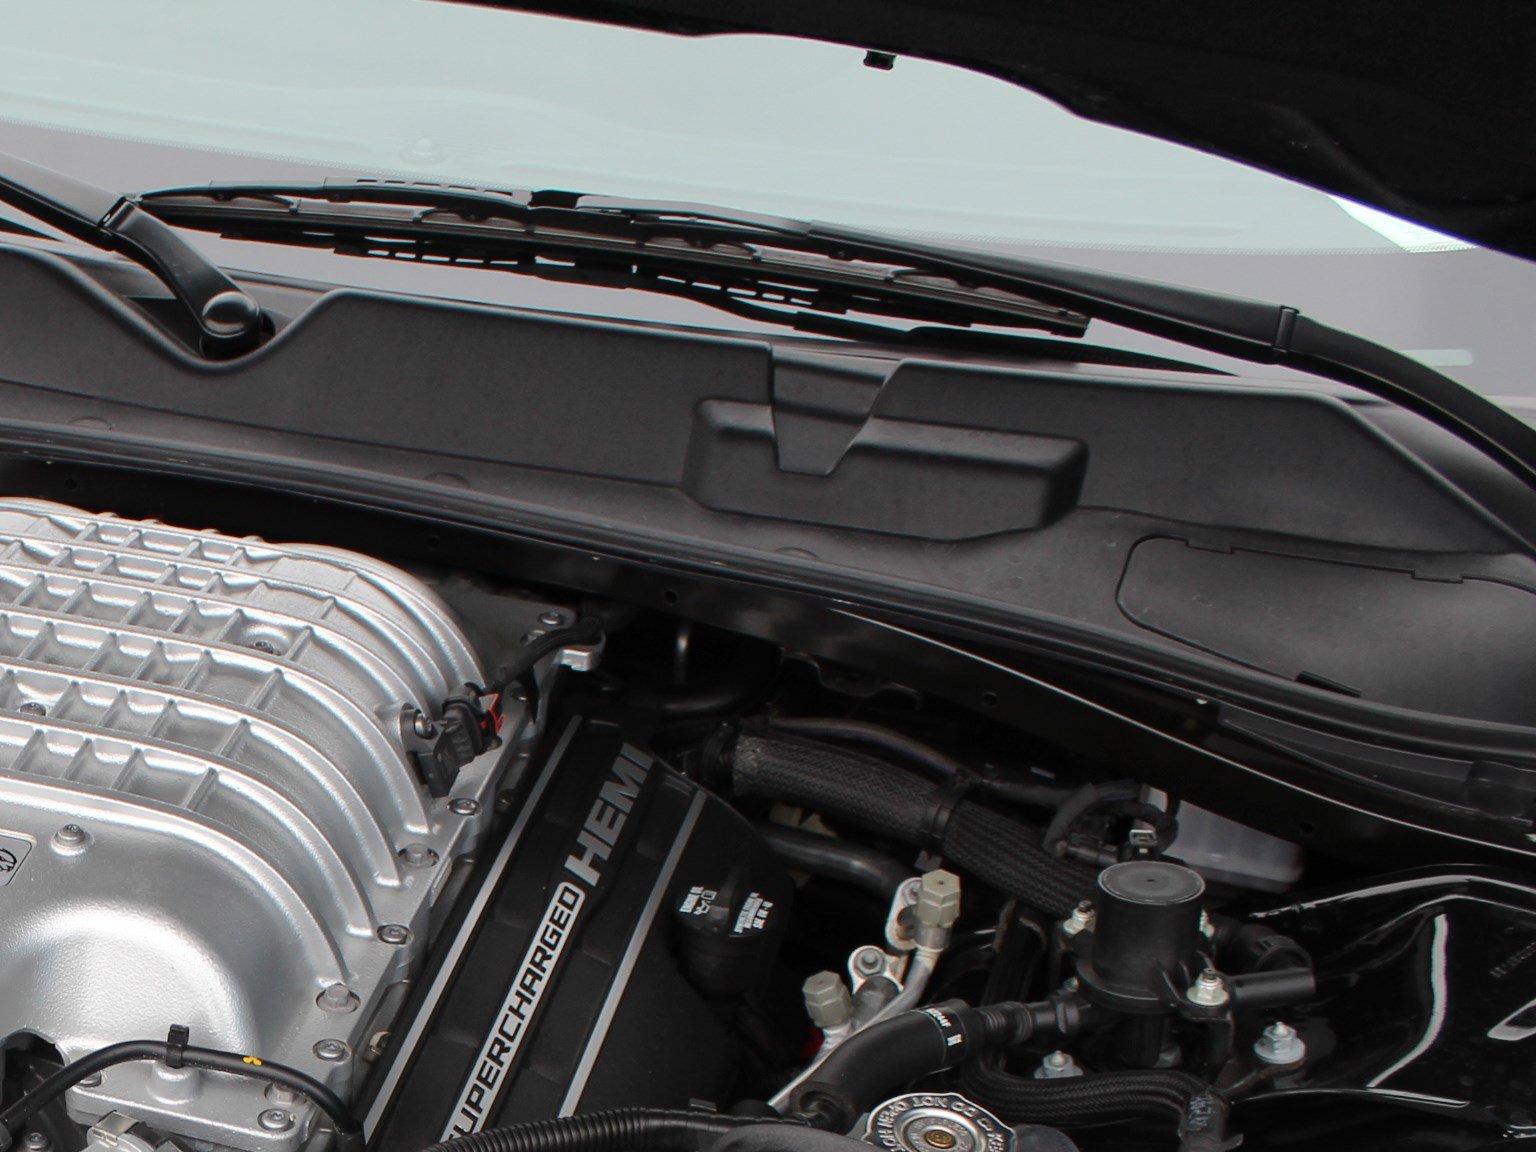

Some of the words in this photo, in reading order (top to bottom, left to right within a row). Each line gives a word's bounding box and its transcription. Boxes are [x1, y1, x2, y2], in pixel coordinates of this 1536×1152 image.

[447, 884, 583, 1140] UPERCHARGED
[564, 742, 655, 887] HEMI
[912, 1096, 950, 1109] NOT
[951, 1101, 977, 1118] DO
[877, 1101, 911, 1129] OPEN
